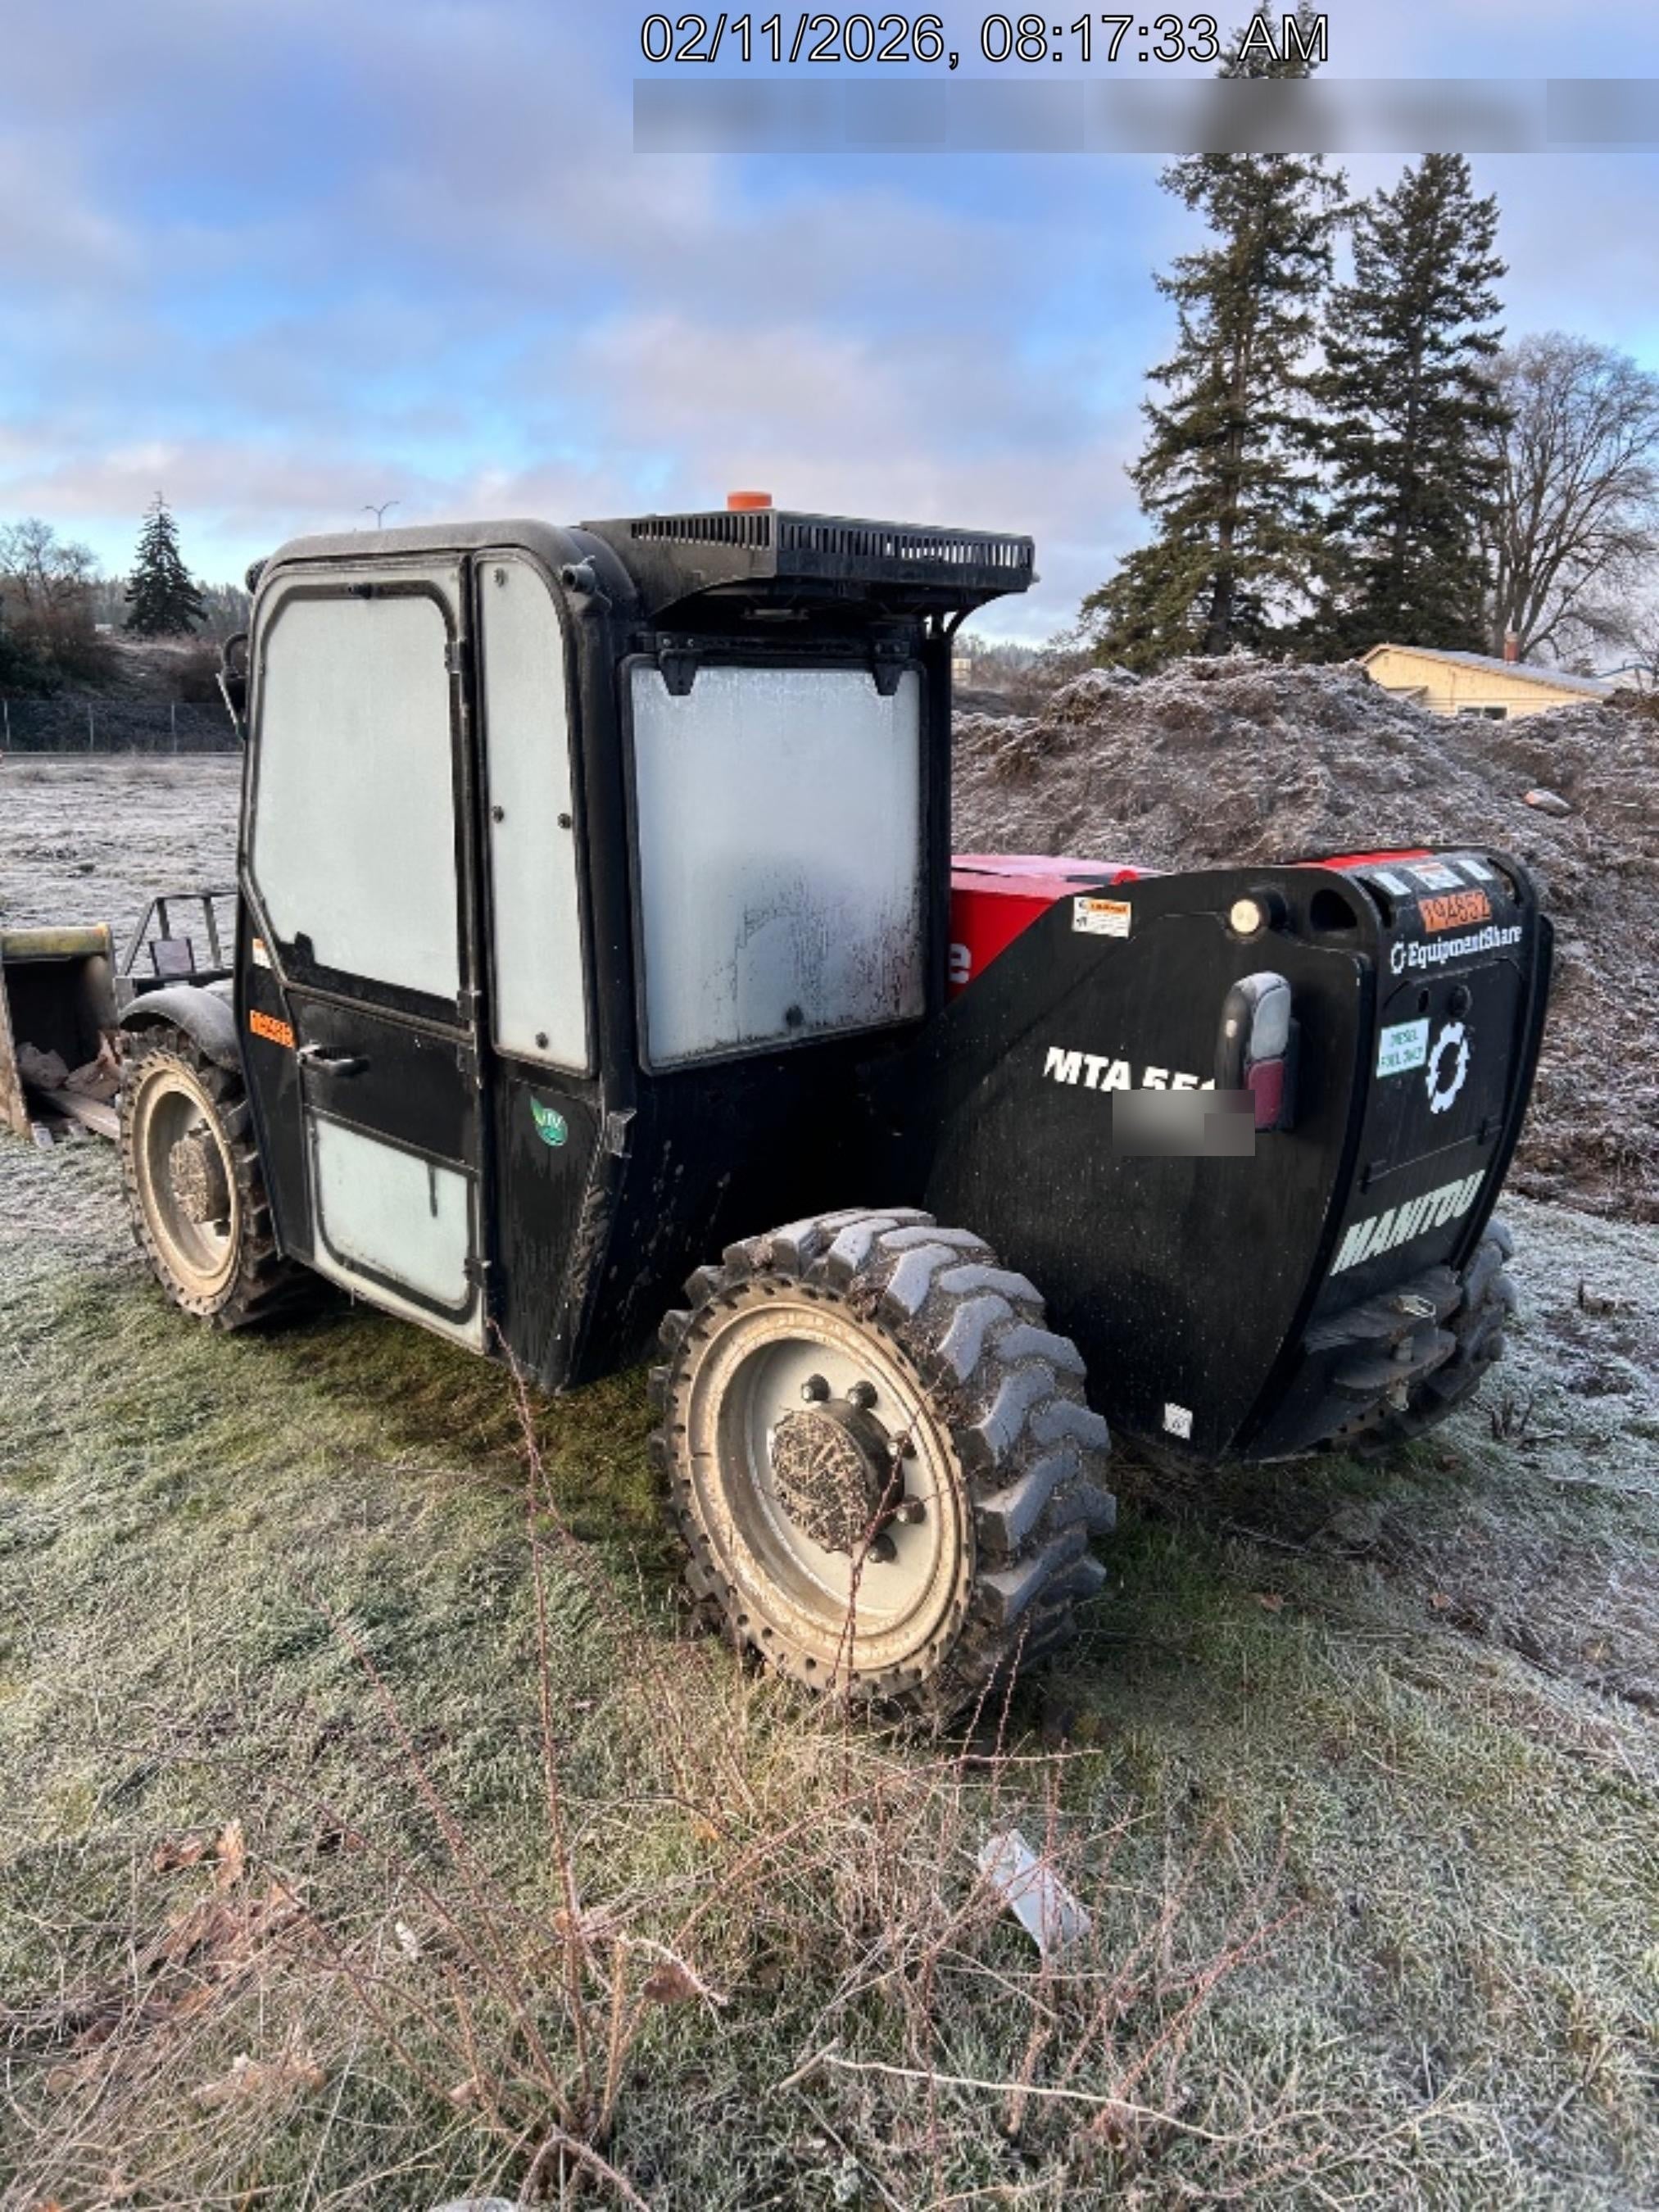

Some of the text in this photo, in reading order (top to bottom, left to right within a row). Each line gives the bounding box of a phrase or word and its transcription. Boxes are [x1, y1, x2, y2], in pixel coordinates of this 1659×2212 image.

[1408, 927, 1521, 968] EquipmentShare
[1042, 1046, 1131, 1092] MTA
[1329, 1169, 1486, 1276] MANITOU
